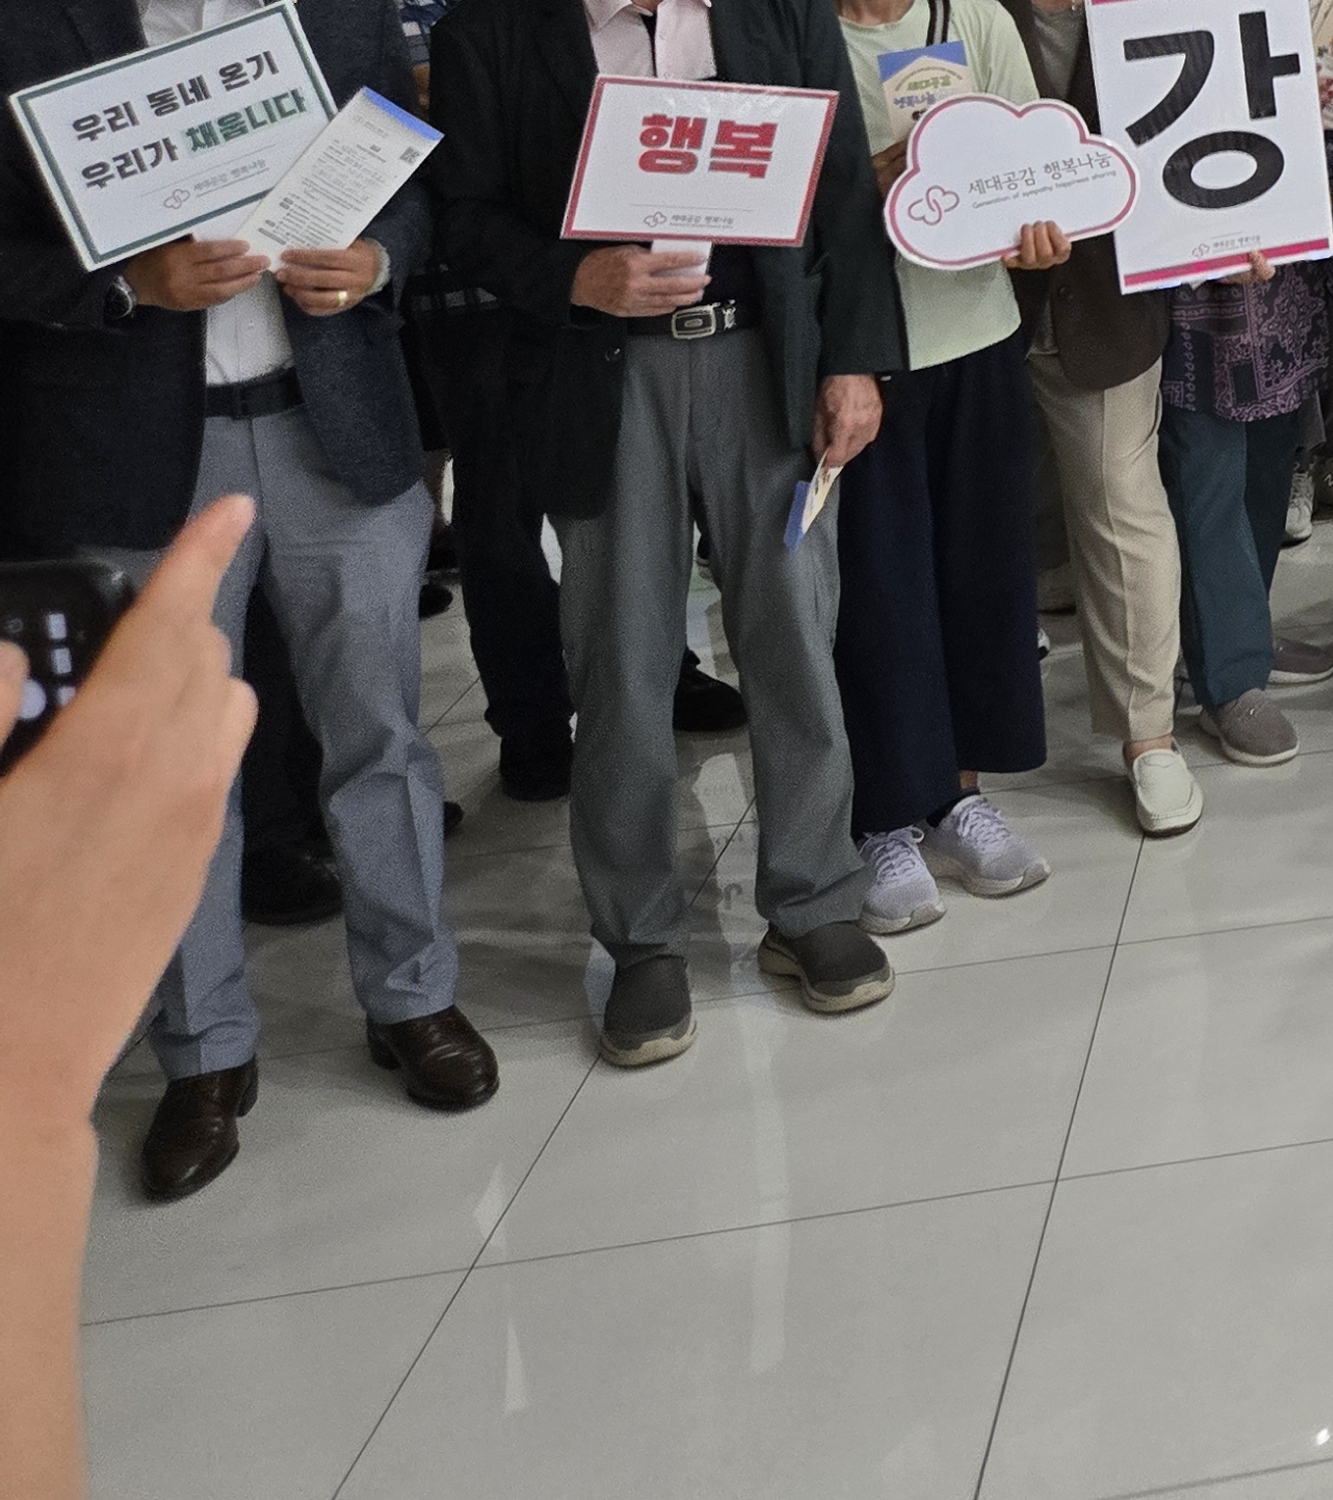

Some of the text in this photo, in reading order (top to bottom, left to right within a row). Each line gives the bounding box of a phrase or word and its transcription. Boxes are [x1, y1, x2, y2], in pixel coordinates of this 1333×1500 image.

[72, 50, 280, 142] 우리 동네 온기
[1125, 11, 1301, 210] 강
[81, 136, 179, 189] 우리가
[638, 113, 779, 179] 행복
[968, 150, 1113, 195] 세대공감 행복나눔
[1091, 169, 1117, 183] sharing
